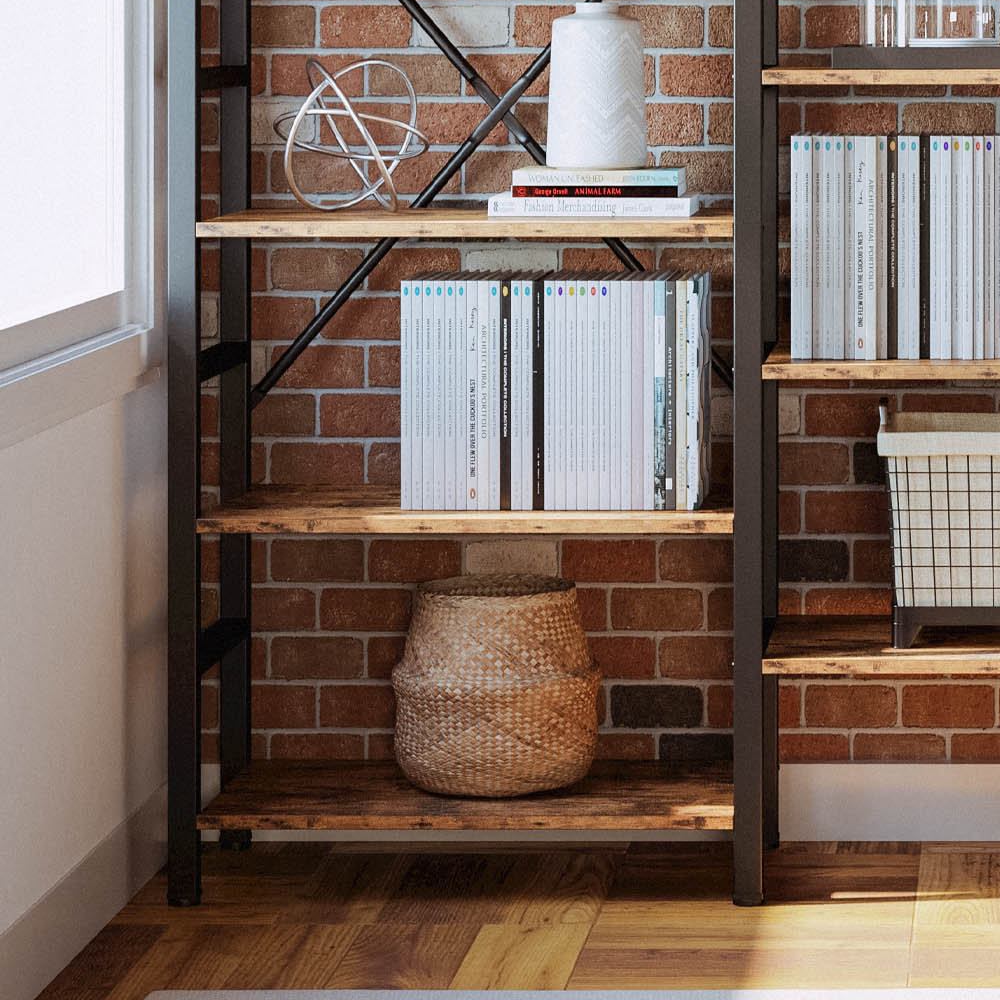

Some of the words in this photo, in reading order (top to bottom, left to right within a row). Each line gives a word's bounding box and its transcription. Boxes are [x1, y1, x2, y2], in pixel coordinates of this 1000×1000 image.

[534, 188, 552, 196] George
[574, 187, 601, 195] ANIMAL
[602, 187, 622, 195] FARM
[524, 199, 554, 212] Fashion
[557, 199, 616, 217] Merchandising
